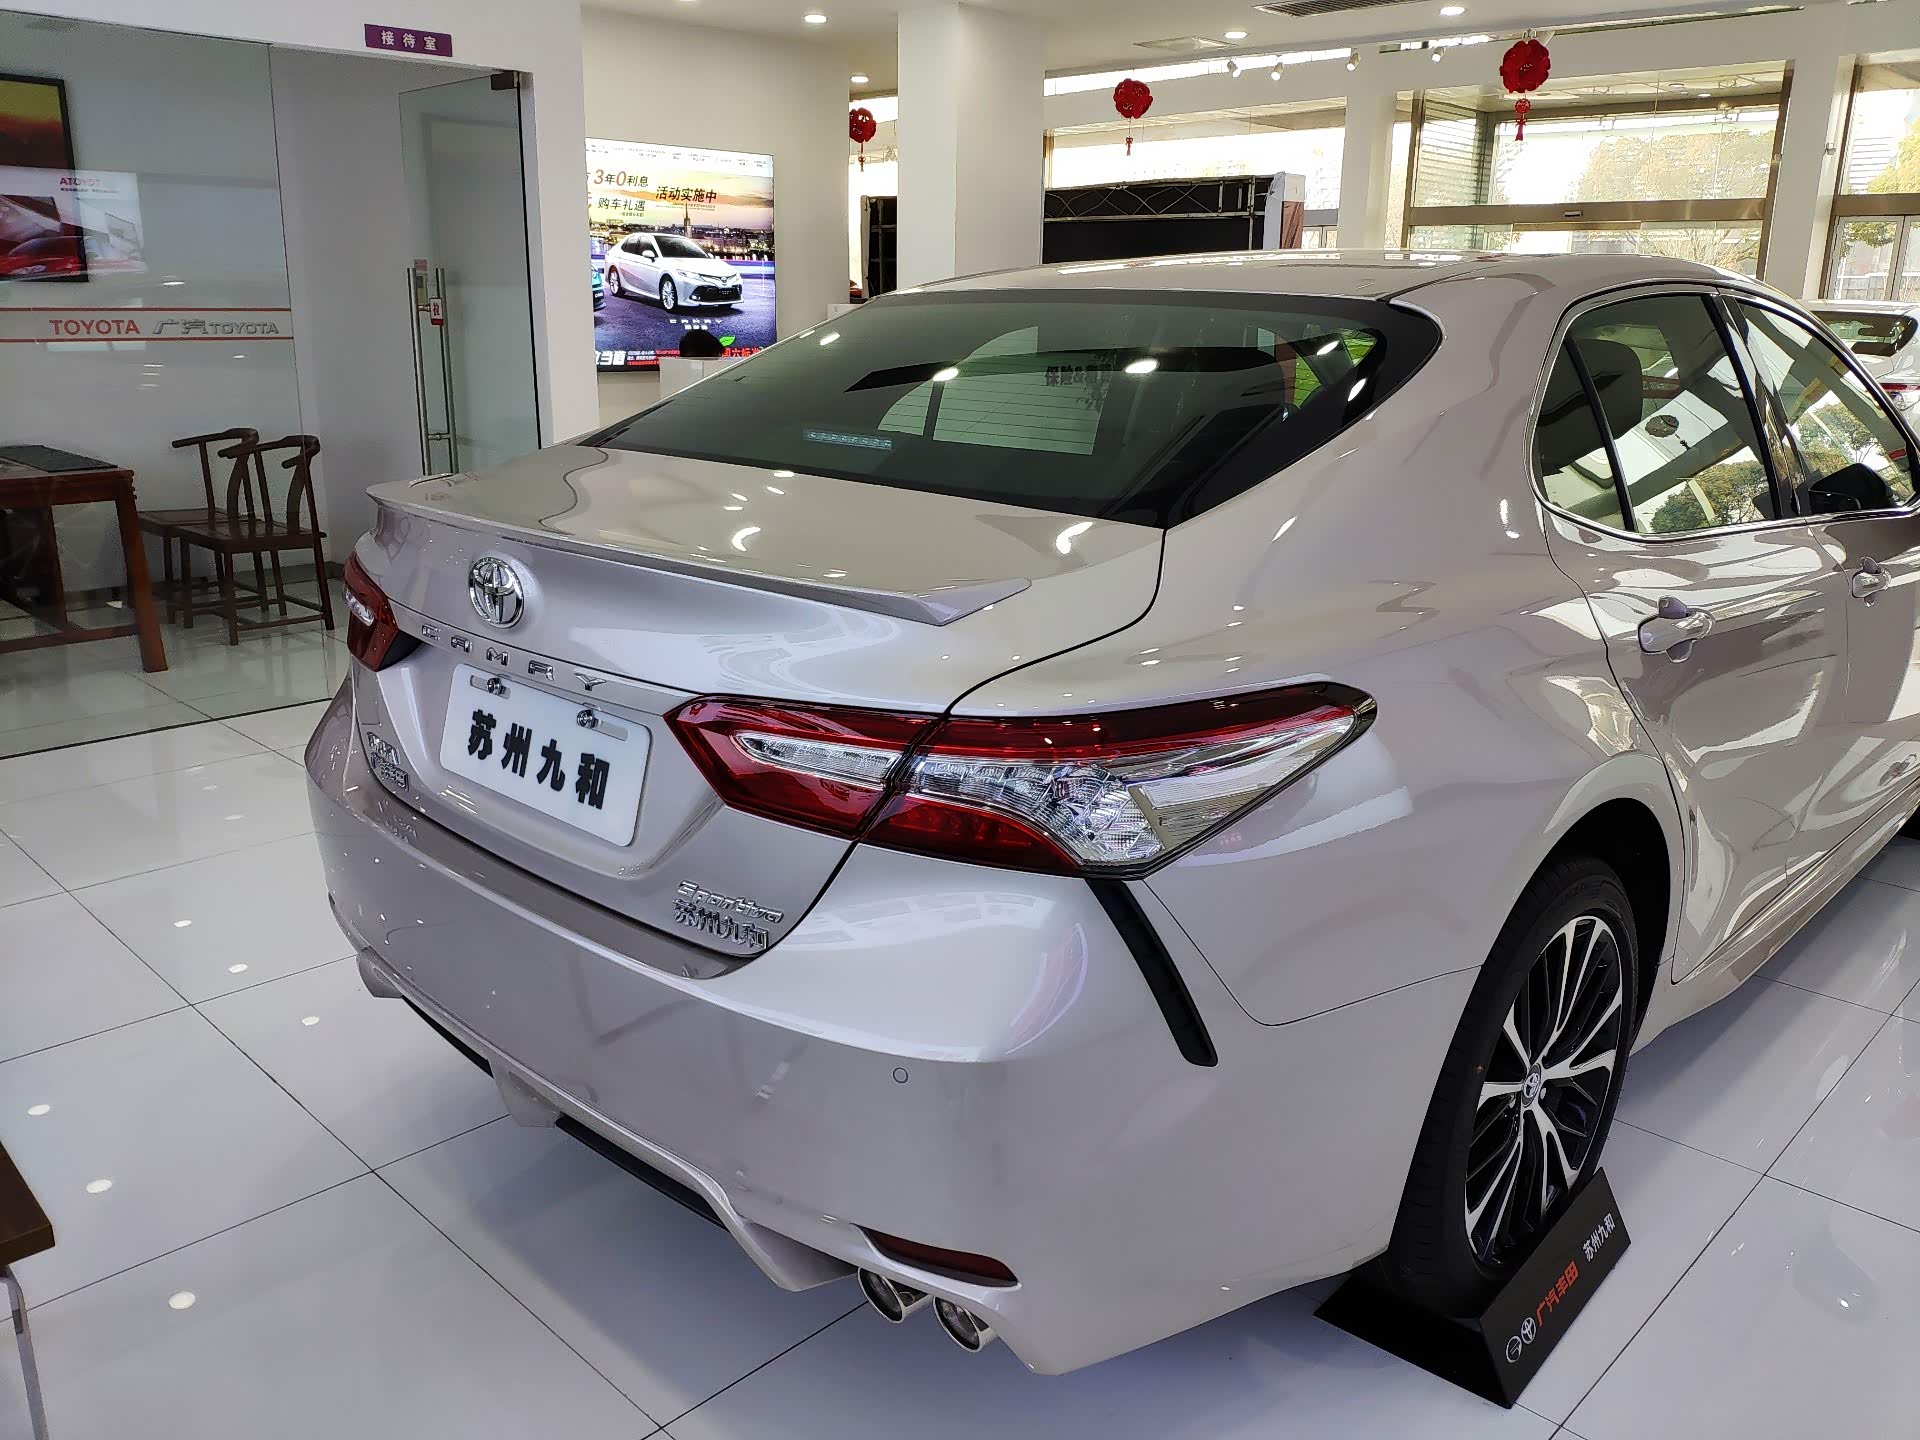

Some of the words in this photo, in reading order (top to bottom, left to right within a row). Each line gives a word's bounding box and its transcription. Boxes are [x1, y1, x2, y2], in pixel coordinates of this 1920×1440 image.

[380, 30, 437, 51] 接待室
[593, 169, 649, 187] 3年0利息
[598, 197, 646, 212] 购车礼遇
[655, 186, 717, 204] 活动实施中
[49, 319, 140, 335] TOYOTA
[421, 623, 607, 692] CAMRY
[467, 708, 611, 811] 苏州九和
[672, 898, 770, 950] 苏州九和
[1535, 1260, 1580, 1328] 广汽丰田
[1582, 1212, 1616, 1263] 苏州九和
